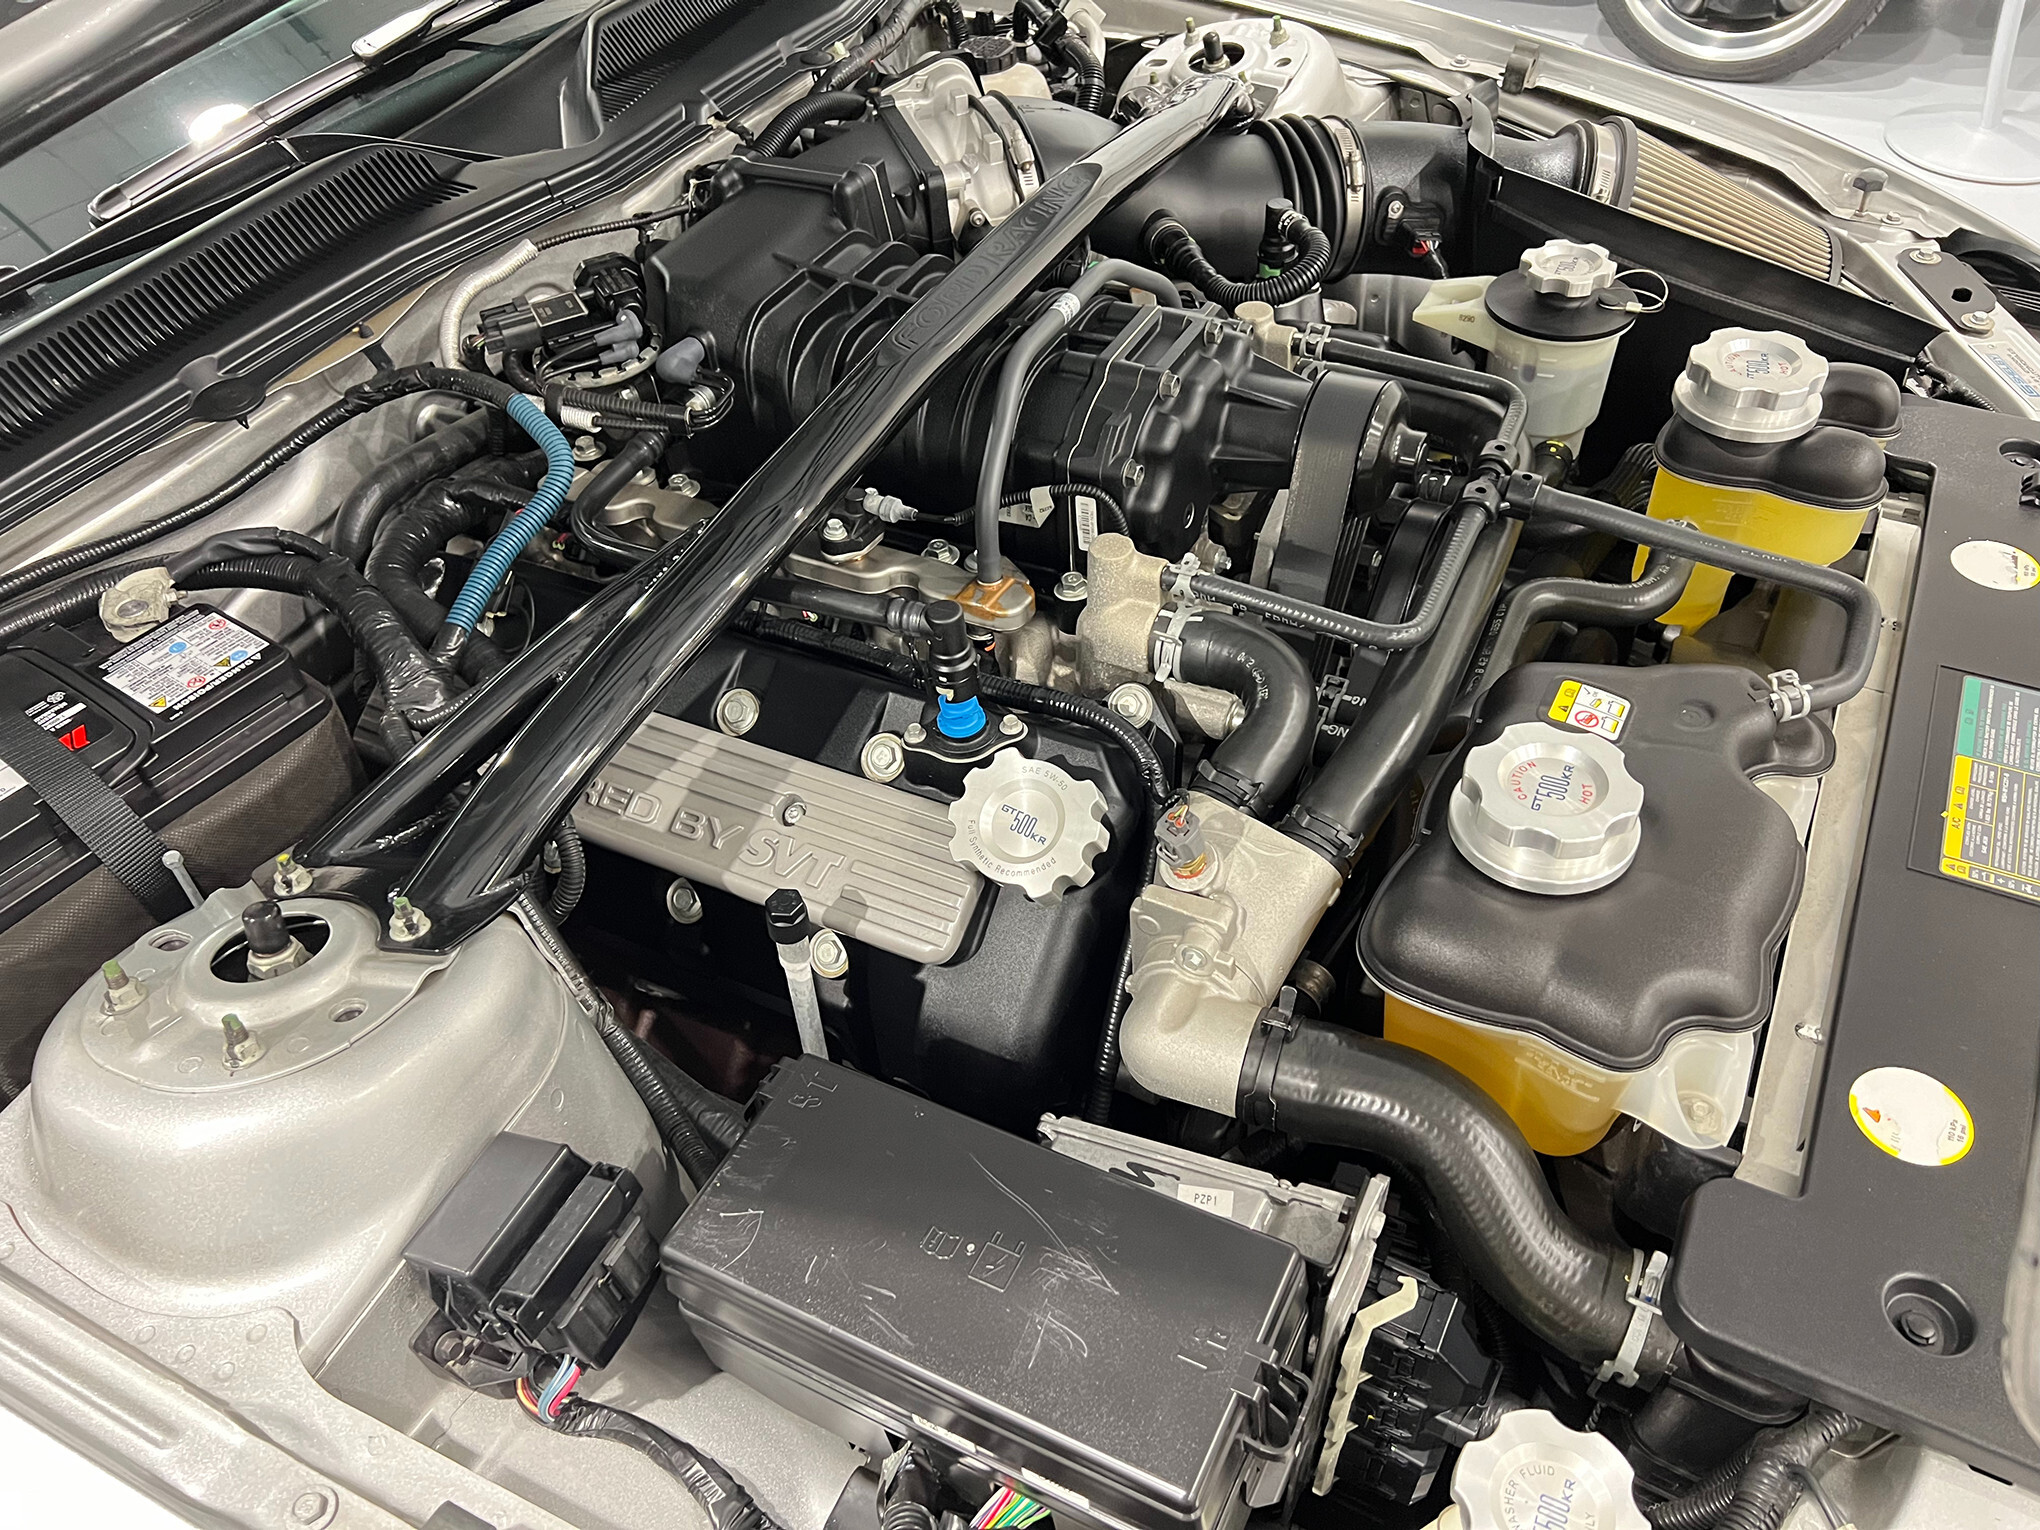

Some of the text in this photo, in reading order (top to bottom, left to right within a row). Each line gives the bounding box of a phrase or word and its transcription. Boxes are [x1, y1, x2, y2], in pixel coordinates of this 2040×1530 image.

[892, 170, 1092, 350] FORD RACING
[1021, 765, 1069, 792] SAE 5W-50
[1510, 761, 1537, 801] CAUTION
[1580, 783, 1593, 805] HOT
[669, 806, 745, 850] BY
[738, 829, 848, 890] SVT
[968, 819, 1057, 878] Full Synthetic Recommended
[1193, 1193, 1217, 1206] PZP1
[1519, 1464, 1556, 1480] FLUID
